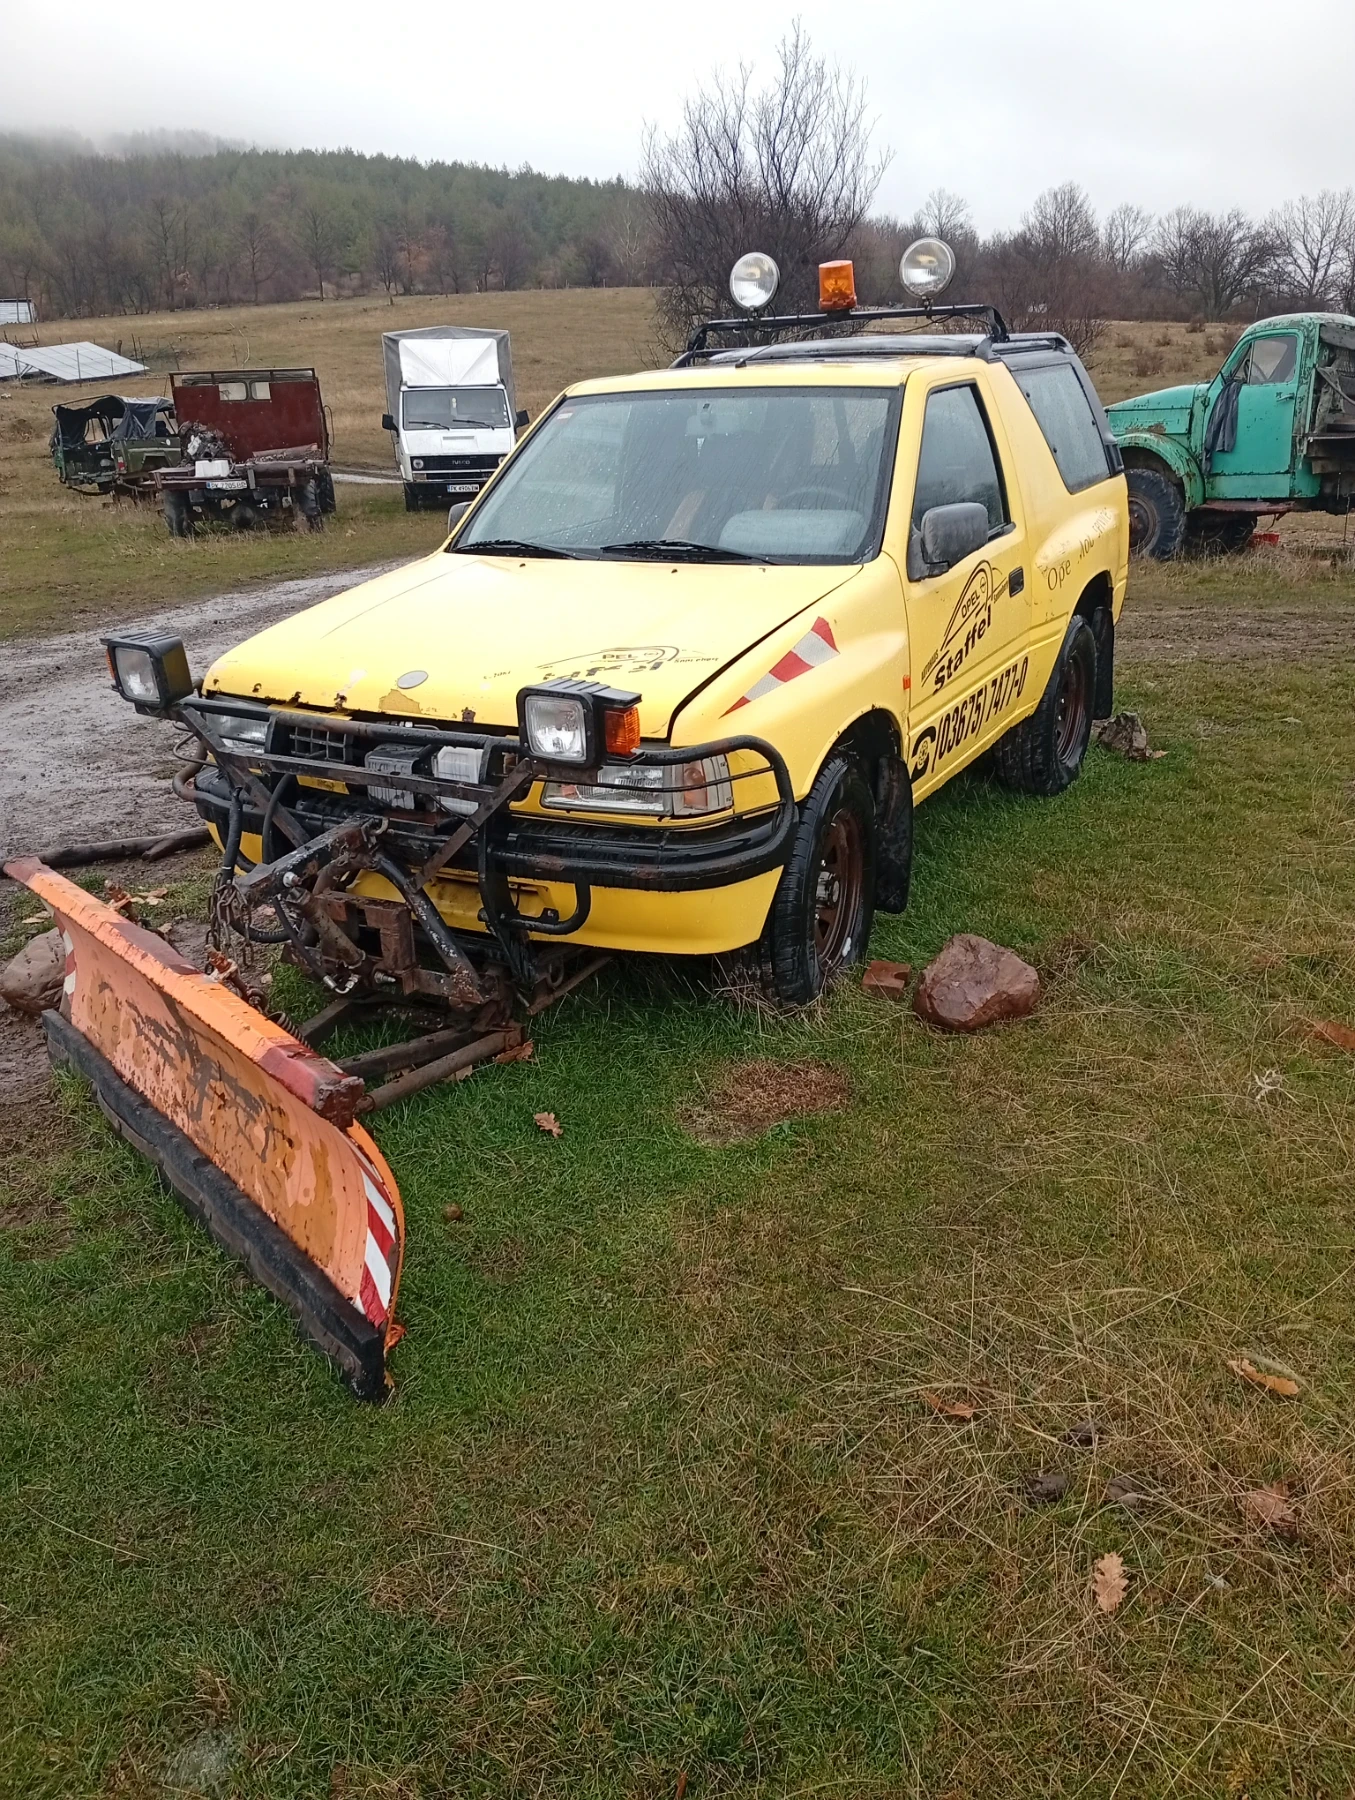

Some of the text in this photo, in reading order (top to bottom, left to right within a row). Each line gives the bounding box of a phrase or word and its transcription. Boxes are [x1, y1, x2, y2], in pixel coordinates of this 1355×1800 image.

[933, 604, 991, 696] Staffel
[961, 589, 980, 619] OPEL
[931, 656, 1029, 774] (03675) 7477-0
